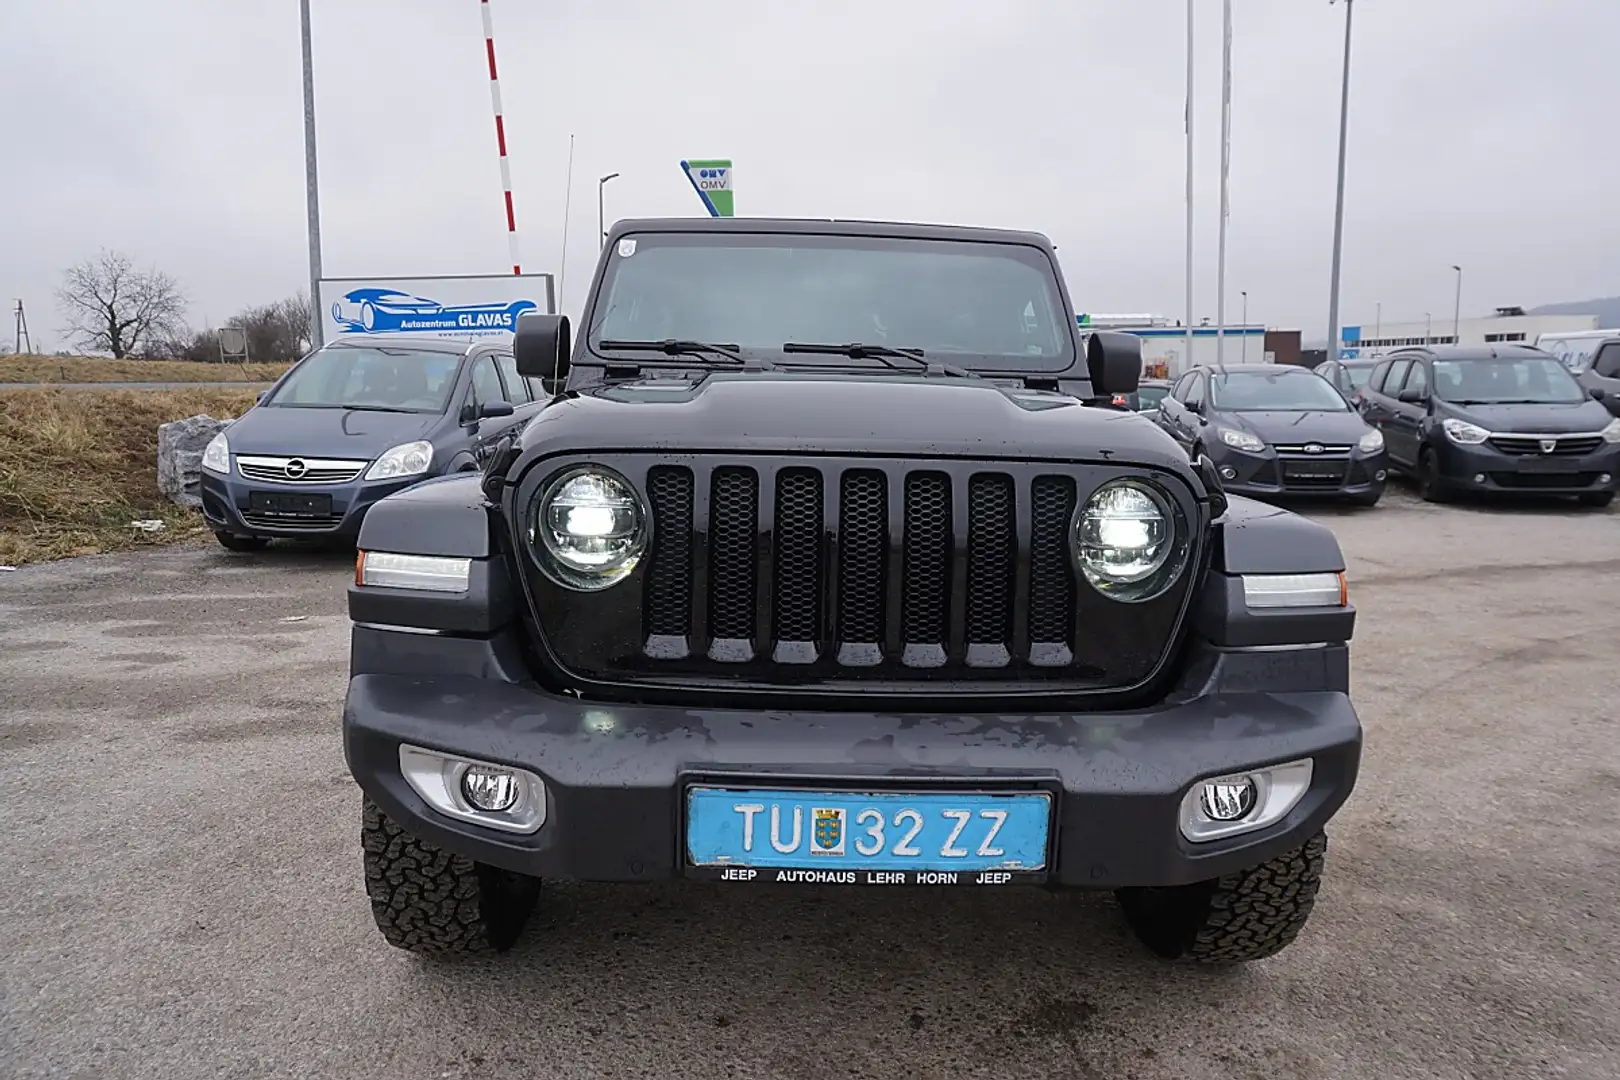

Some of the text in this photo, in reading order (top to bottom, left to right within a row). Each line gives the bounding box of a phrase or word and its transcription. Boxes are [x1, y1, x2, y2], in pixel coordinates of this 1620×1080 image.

[700, 169, 726, 178] OMV
[700, 181, 726, 189] OMV
[401, 313, 512, 329] Autozentrum GLAVAS
[733, 803, 1009, 858] TU 32 ZZ
[720, 869, 1012, 884] JEEP AUTOHAUS LEHR HORN JEEP
